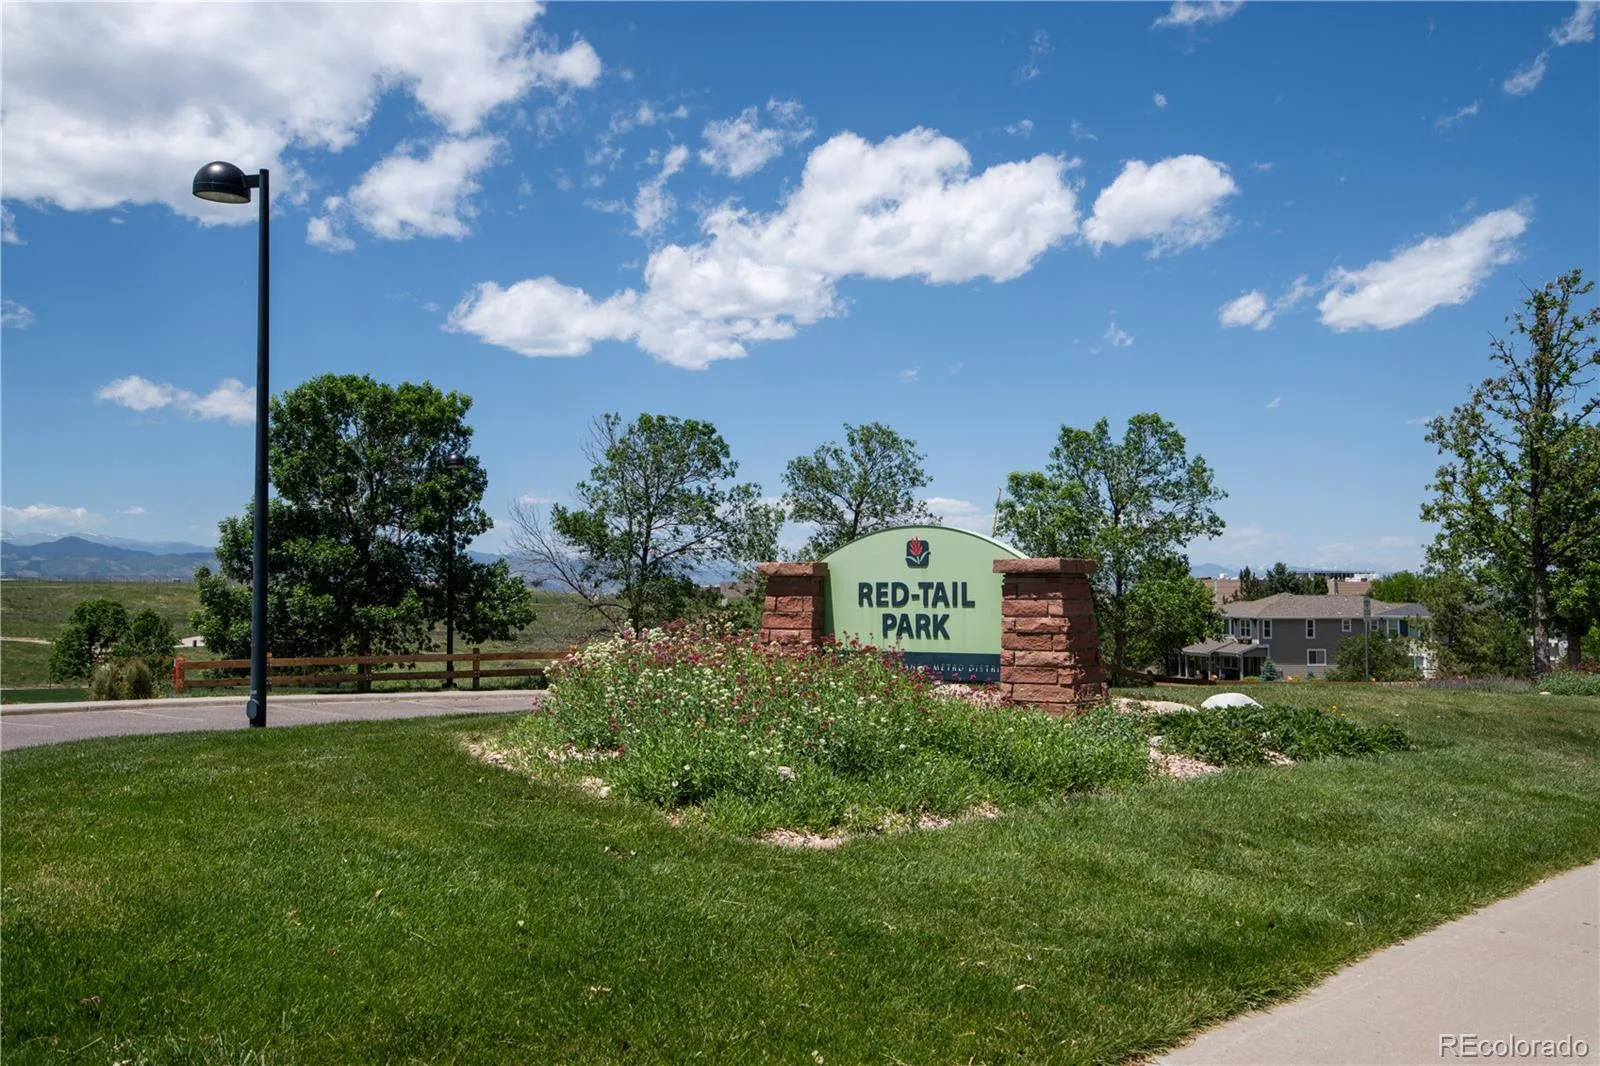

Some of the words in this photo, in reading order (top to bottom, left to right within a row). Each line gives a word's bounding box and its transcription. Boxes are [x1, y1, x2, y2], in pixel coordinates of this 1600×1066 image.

[858, 581, 976, 608] RED-TAIL
[881, 612, 951, 640] PARK
[932, 663, 965, 672] METRO
[968, 664, 1000, 673] DISTRI
